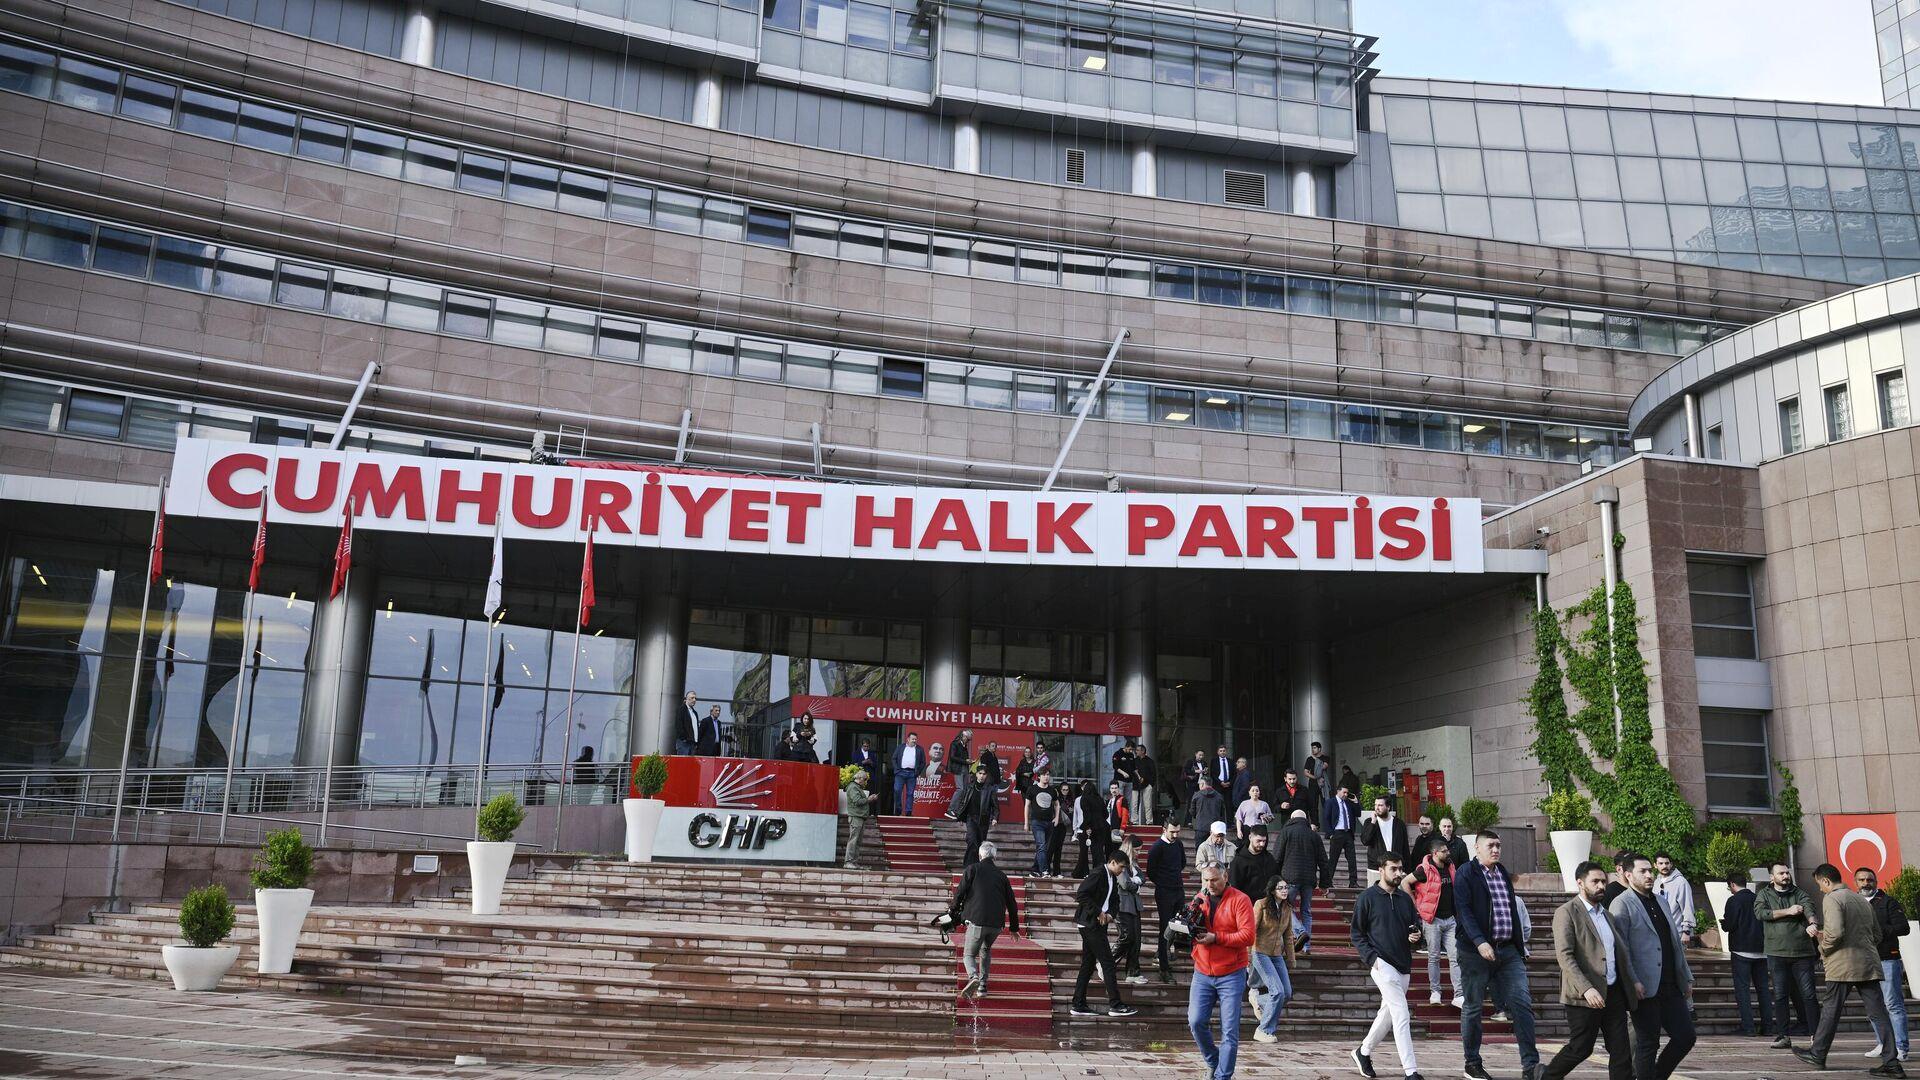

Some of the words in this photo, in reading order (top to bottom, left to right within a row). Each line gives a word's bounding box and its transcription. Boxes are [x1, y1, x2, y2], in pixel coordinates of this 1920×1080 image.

[207, 453, 822, 545] CUMHURİYET
[853, 495, 1094, 554] HALK
[1127, 496, 1453, 561] PARTİSİ
[866, 706, 967, 723] CUMHURİYET
[972, 713, 1012, 726] HALK
[1017, 714, 1075, 729] PARTİSİ
[688, 813, 787, 849] CHP
